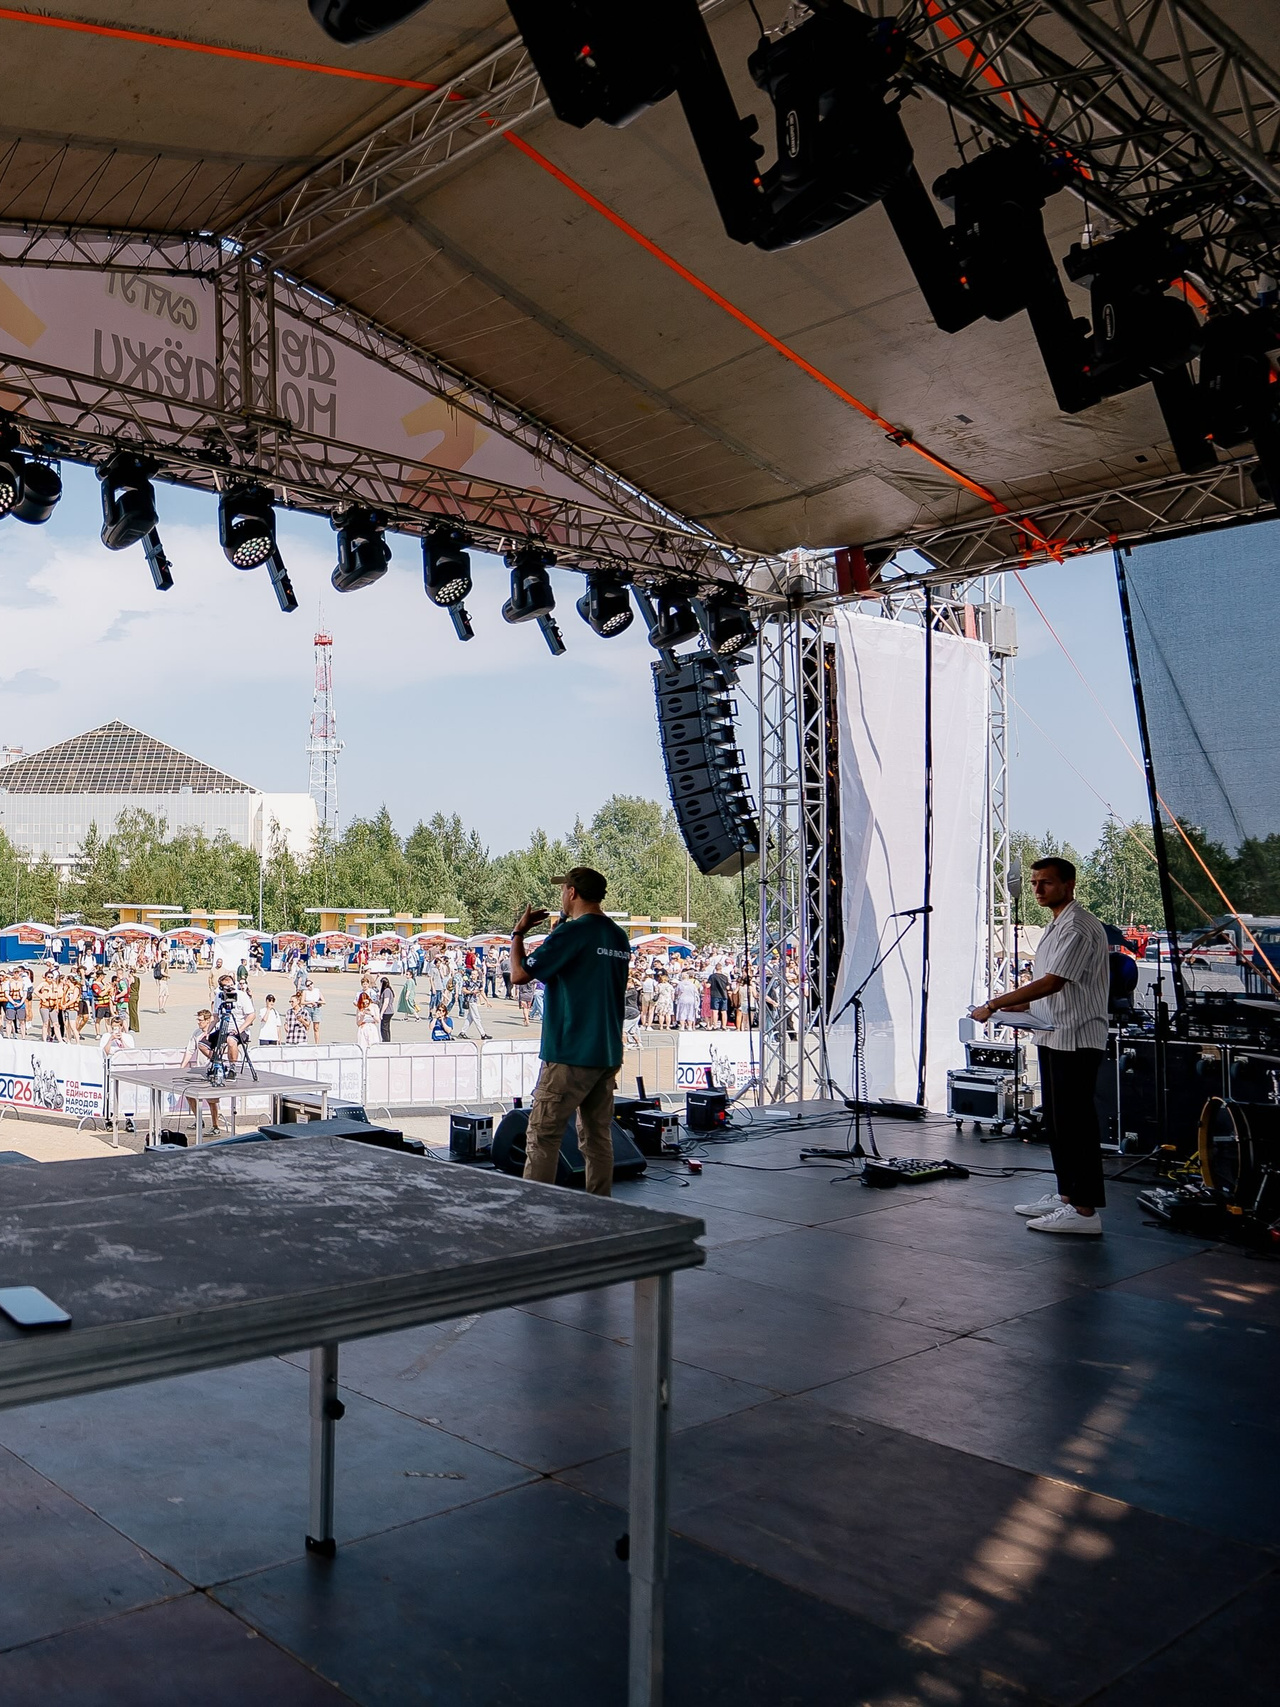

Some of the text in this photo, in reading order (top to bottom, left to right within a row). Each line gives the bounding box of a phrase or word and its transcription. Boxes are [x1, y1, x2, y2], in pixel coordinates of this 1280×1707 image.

[66, 1080, 79, 1089] ГОД
[66, 1089, 102, 1100] ЕДИНСТВА
[66, 1098, 99, 1109] НАРОДОВ
[65, 1106, 93, 1116] РОССИИ
